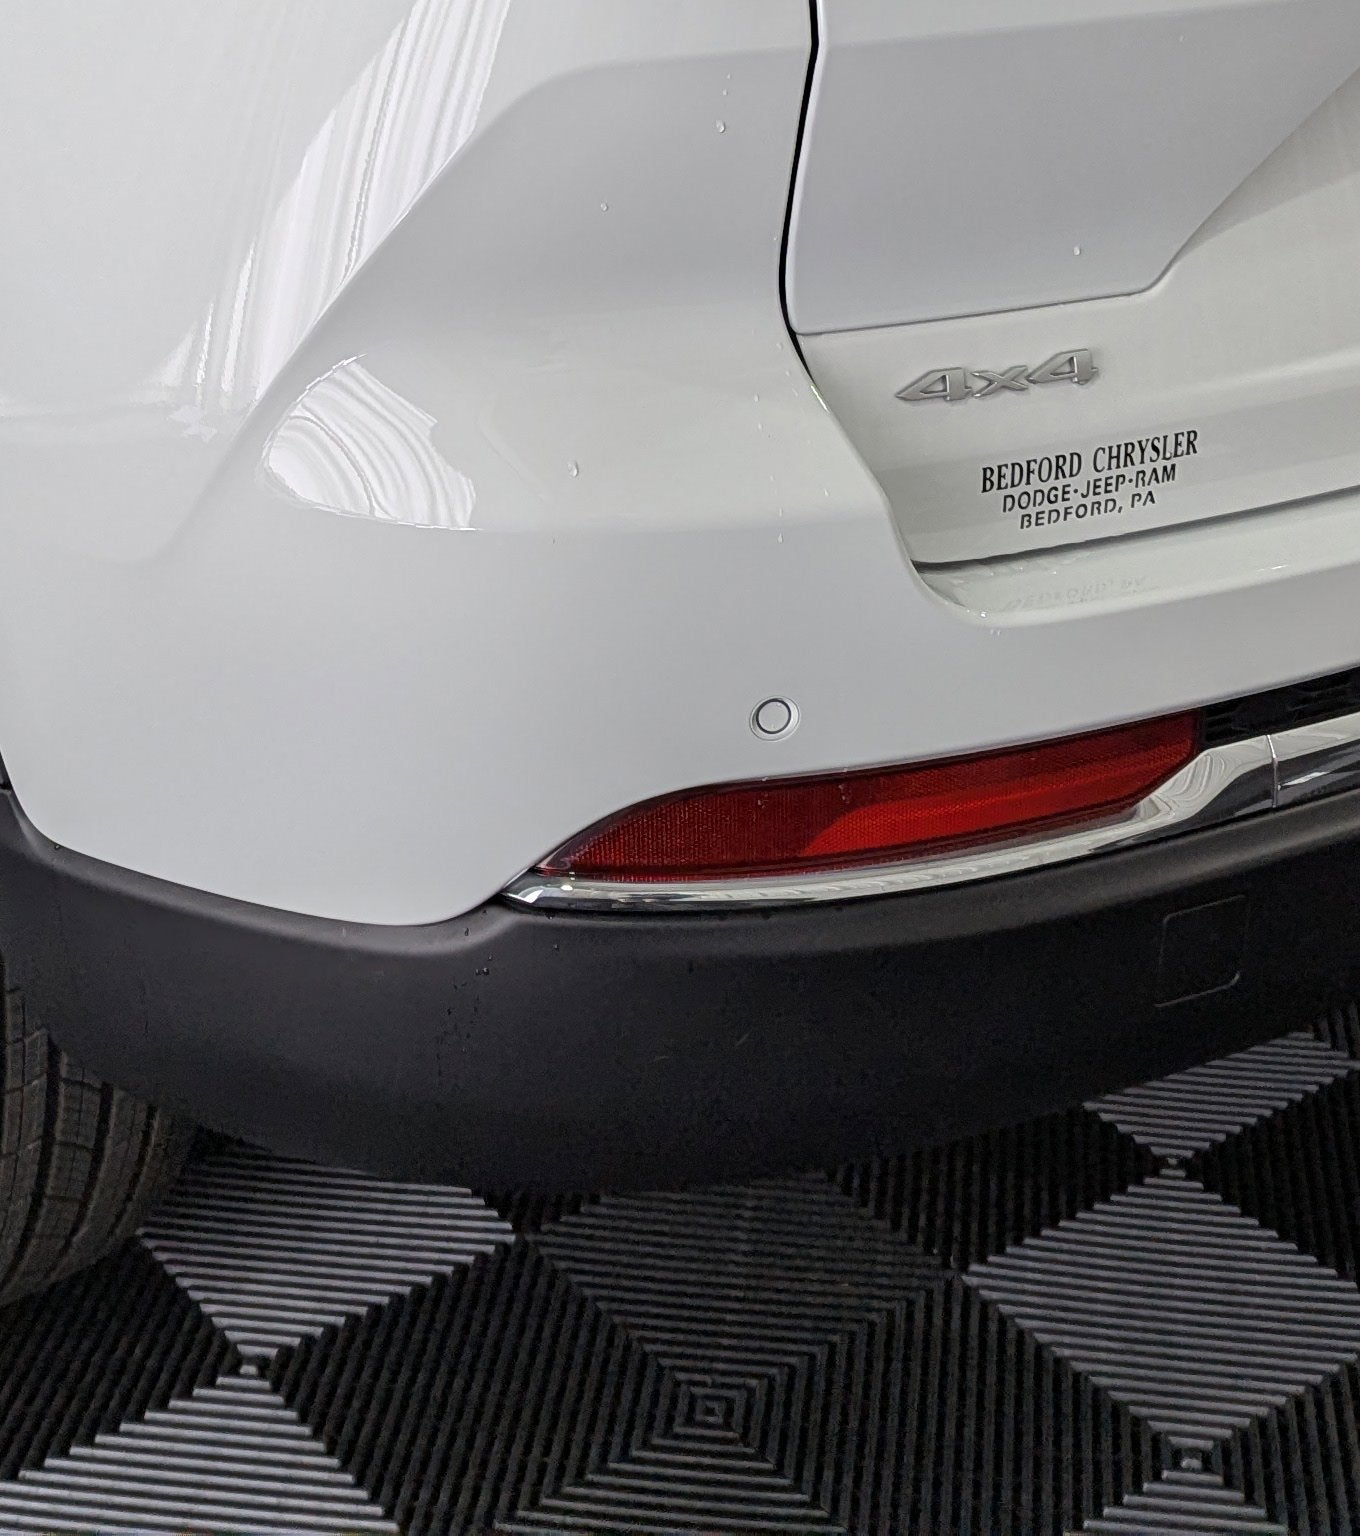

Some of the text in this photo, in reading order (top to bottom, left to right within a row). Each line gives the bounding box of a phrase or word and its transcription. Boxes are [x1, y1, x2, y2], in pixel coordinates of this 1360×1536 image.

[895, 347, 1099, 403] 4x4
[980, 429, 1199, 494] BEDFORD CHRYSLER
[1019, 490, 1156, 530] BEDFORD, PA
